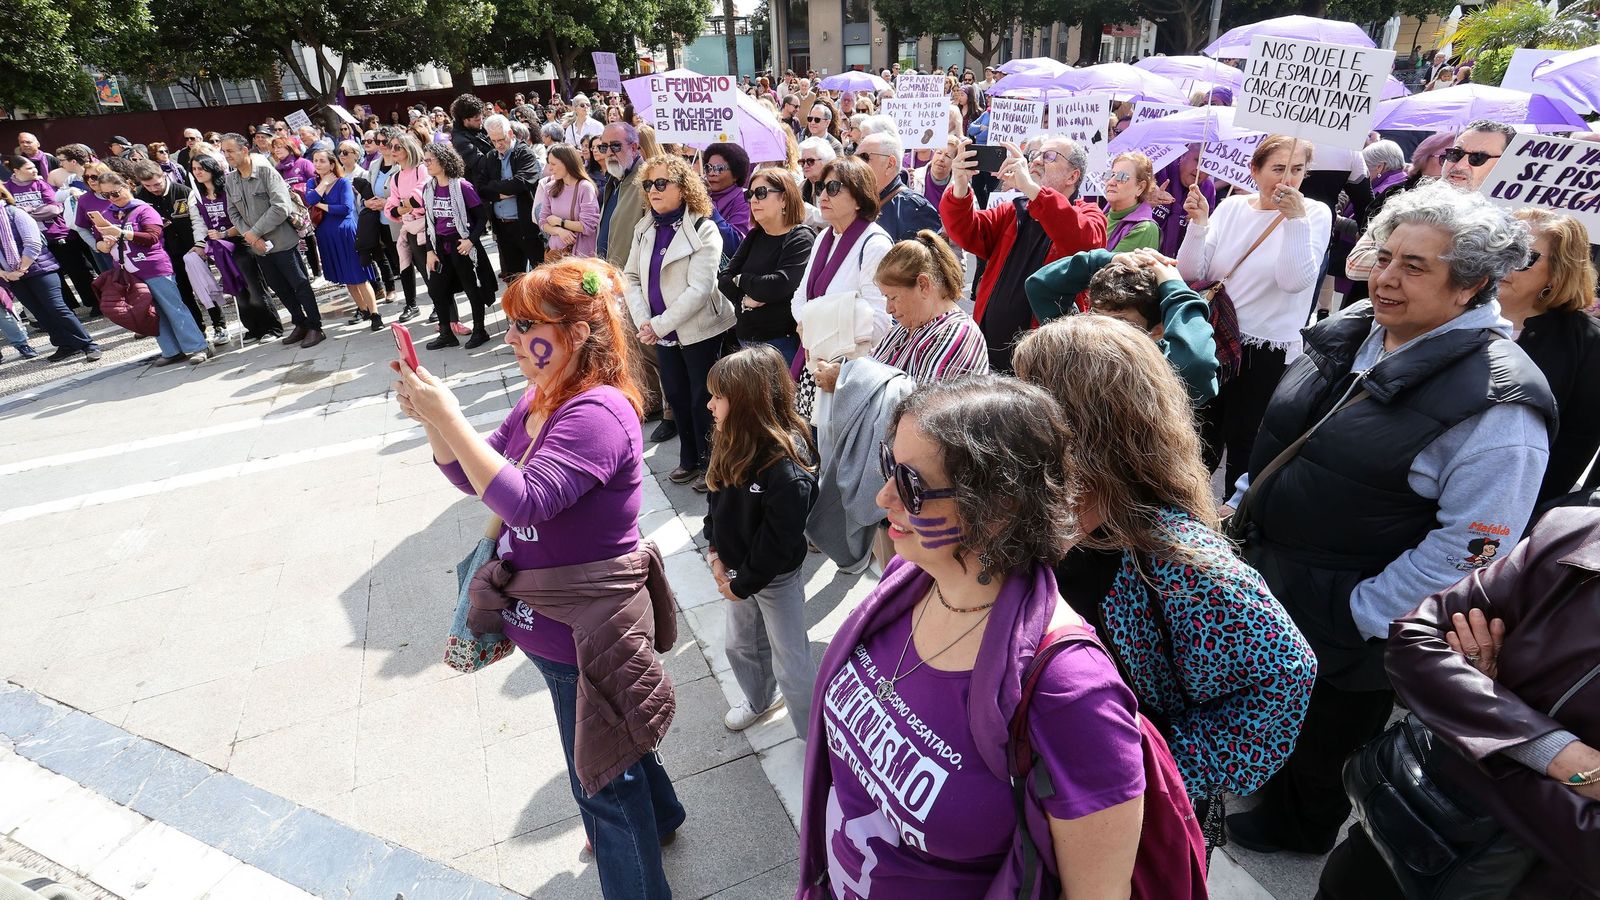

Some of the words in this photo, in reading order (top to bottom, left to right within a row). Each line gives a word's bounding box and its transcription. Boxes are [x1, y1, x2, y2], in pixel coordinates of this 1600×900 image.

[1261, 41, 1296, 61] NOS
[1302, 45, 1366, 71] DUELE
[651, 79, 664, 92] EL
[665, 76, 730, 92] FEMINISMO
[1251, 60, 1269, 77] LA
[1275, 62, 1340, 89] ESPALDA
[1348, 72, 1373, 93] DE
[657, 94, 668, 102] ES
[674, 91, 713, 104] VIDA
[1289, 83, 1320, 105] CON
[1323, 89, 1371, 115] TANTA
[655, 108, 669, 118] EL
[673, 107, 733, 120] MACHISMO
[887, 102, 908, 110] DAME
[918, 110, 945, 118] HABLO
[992, 111, 1001, 121] TU
[657, 120, 670, 131] ES
[674, 119, 723, 131] MUERTE
[920, 119, 936, 127] LOS
[1001, 124, 1011, 133] NO
[1515, 139, 1580, 162] AQUÍ
[1517, 162, 1554, 182] SE
[1490, 180, 1524, 200] LO
[1468, 521, 1510, 536] Mafalda
[854, 643, 873, 670] RENTE
[866, 665, 876, 680] AL
[874, 675, 909, 717] FCISMO
[906, 713, 963, 771] DESATADO,
[825, 660, 946, 819] EMINISMO
